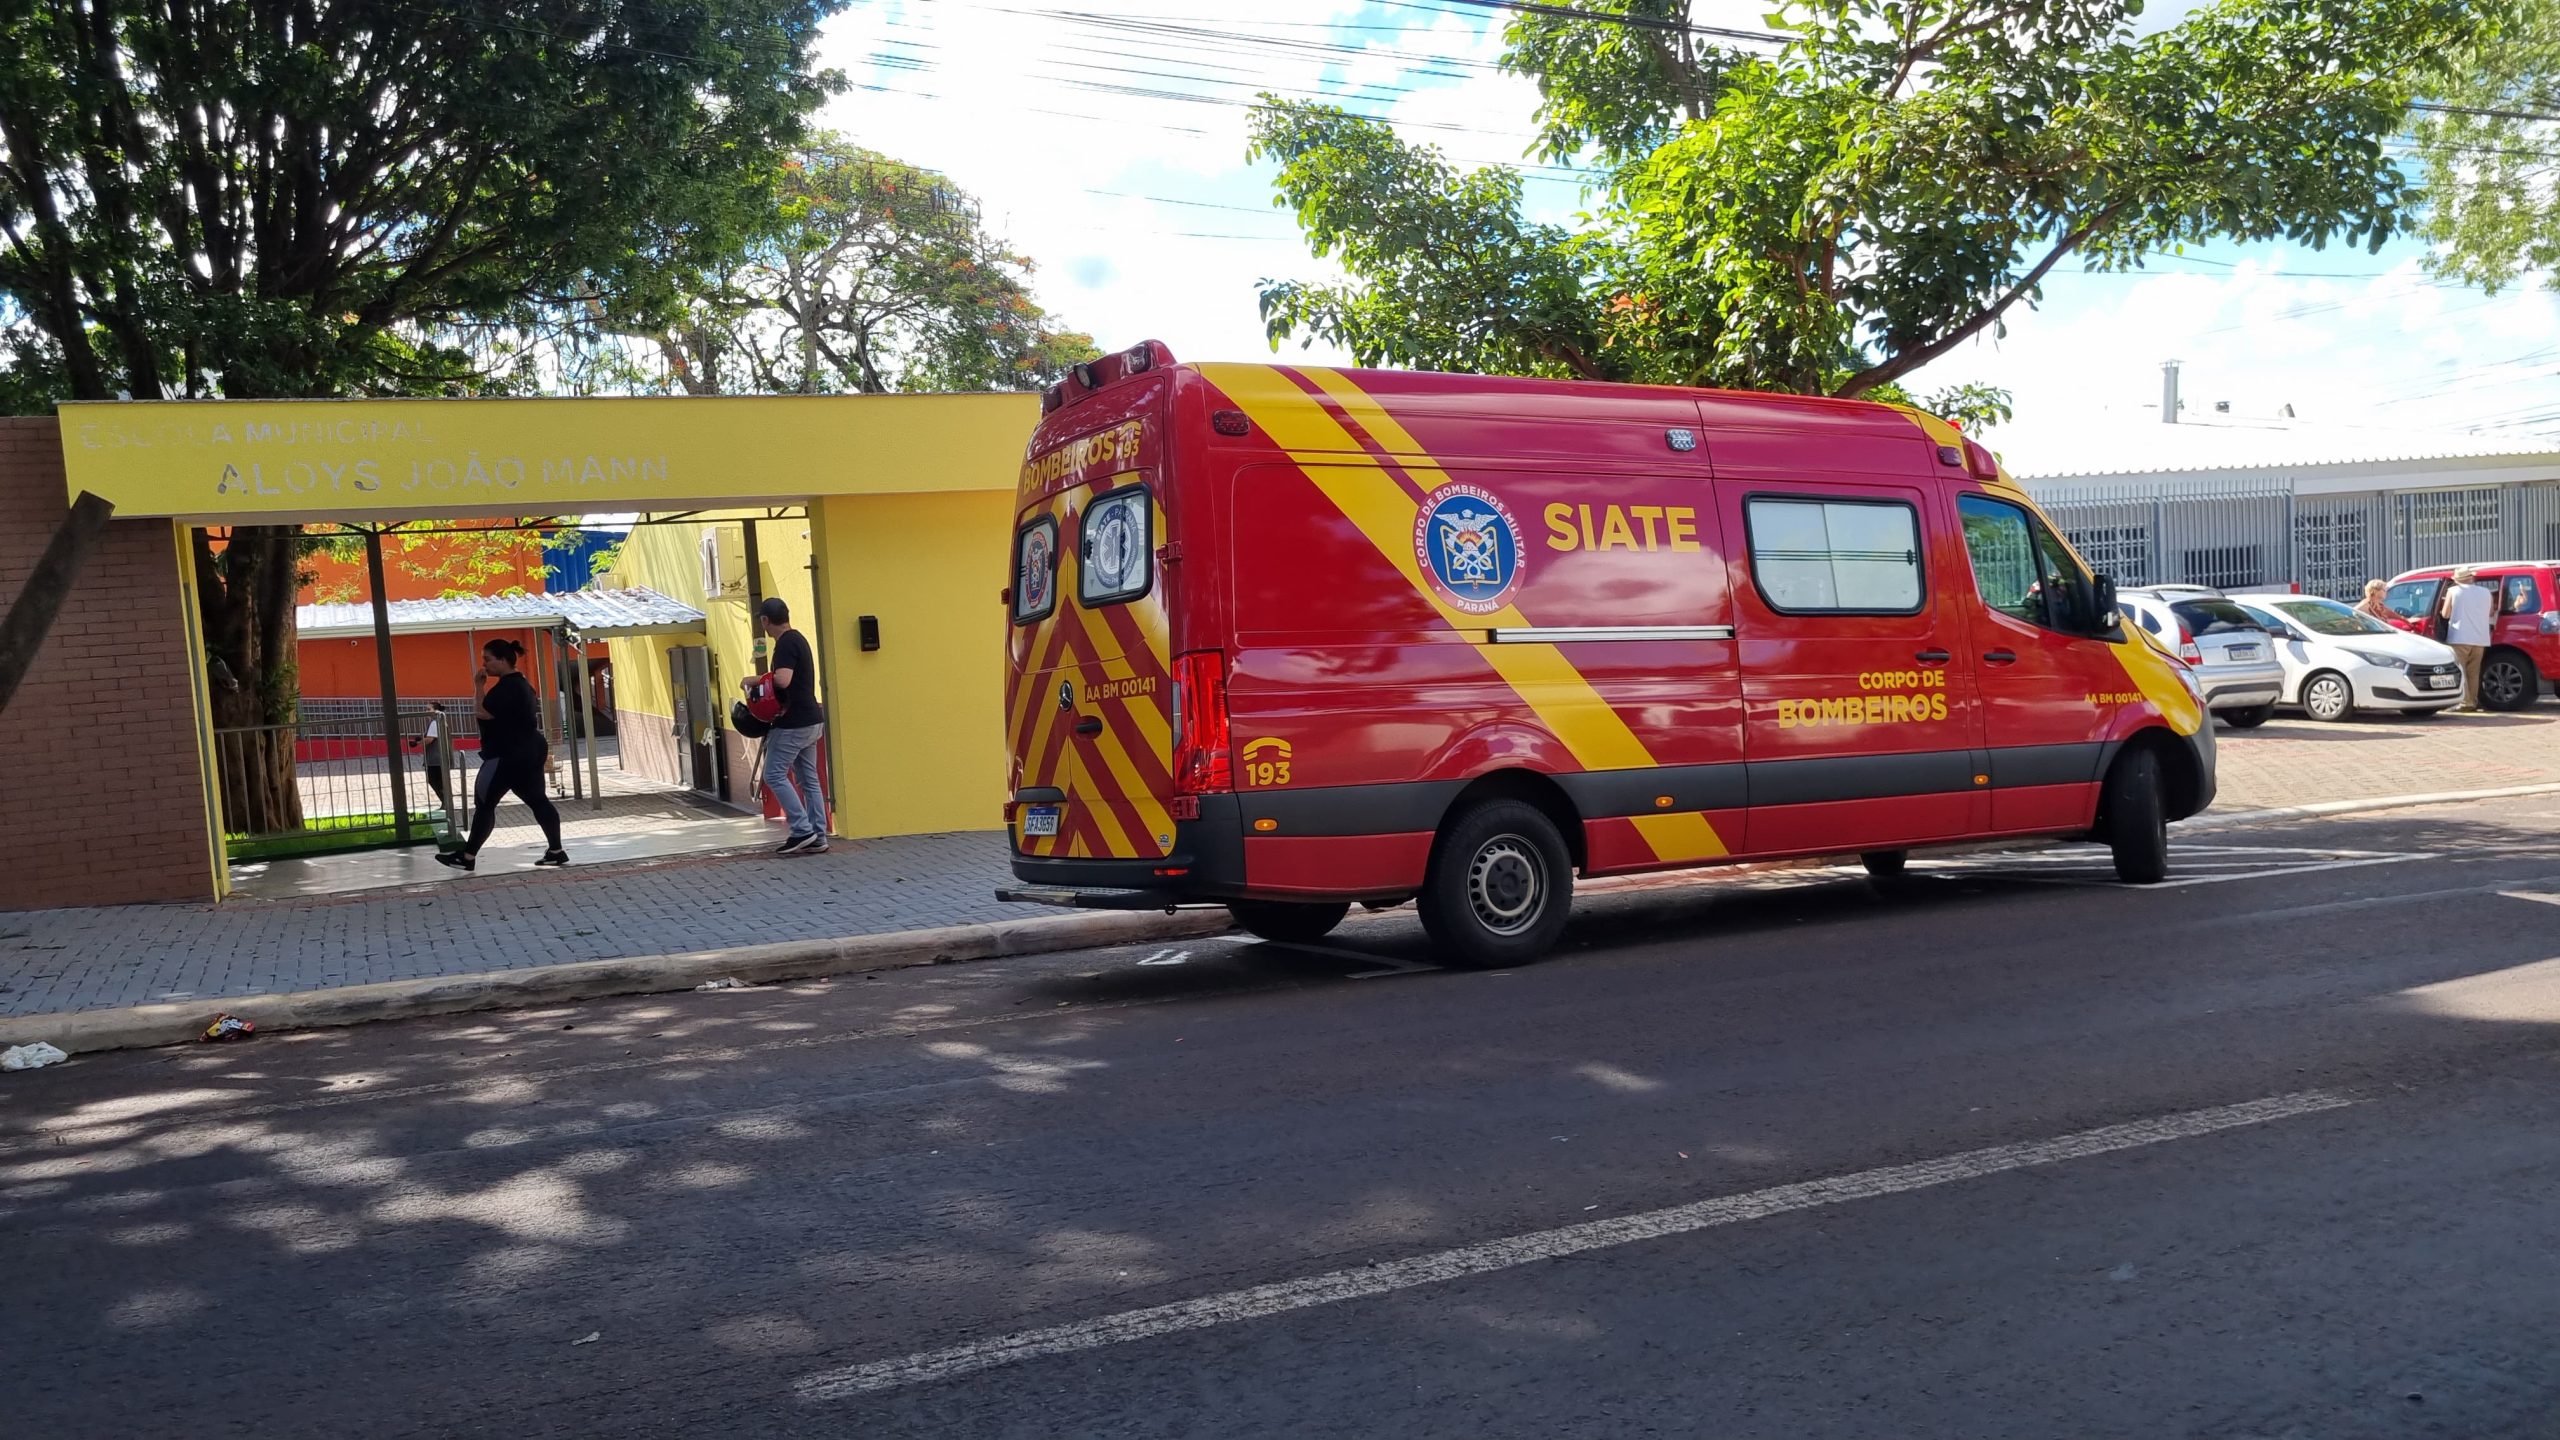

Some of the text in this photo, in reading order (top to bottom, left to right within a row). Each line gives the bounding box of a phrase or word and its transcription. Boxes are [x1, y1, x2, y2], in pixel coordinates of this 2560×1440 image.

[244, 419, 434, 446] MUNICIPAL
[1118, 439, 1140, 460] 193
[217, 450, 668, 495] ALOYS JOÃO MANN
[1023, 430, 1116, 496] BOMBEIROS
[1415, 484, 1526, 568] CORPO DE BOMBEIROS MILITAR
[1543, 502, 1701, 553] SIATE
[1456, 598, 1500, 613] PARANÁ
[1085, 676, 1156, 701] AA BM 00141
[1858, 669, 1946, 690] CORPO DE
[1778, 692, 1948, 729] BOMBEIROS
[2085, 691, 2143, 704] AA BM 00141
[1245, 761, 1292, 786] 193
